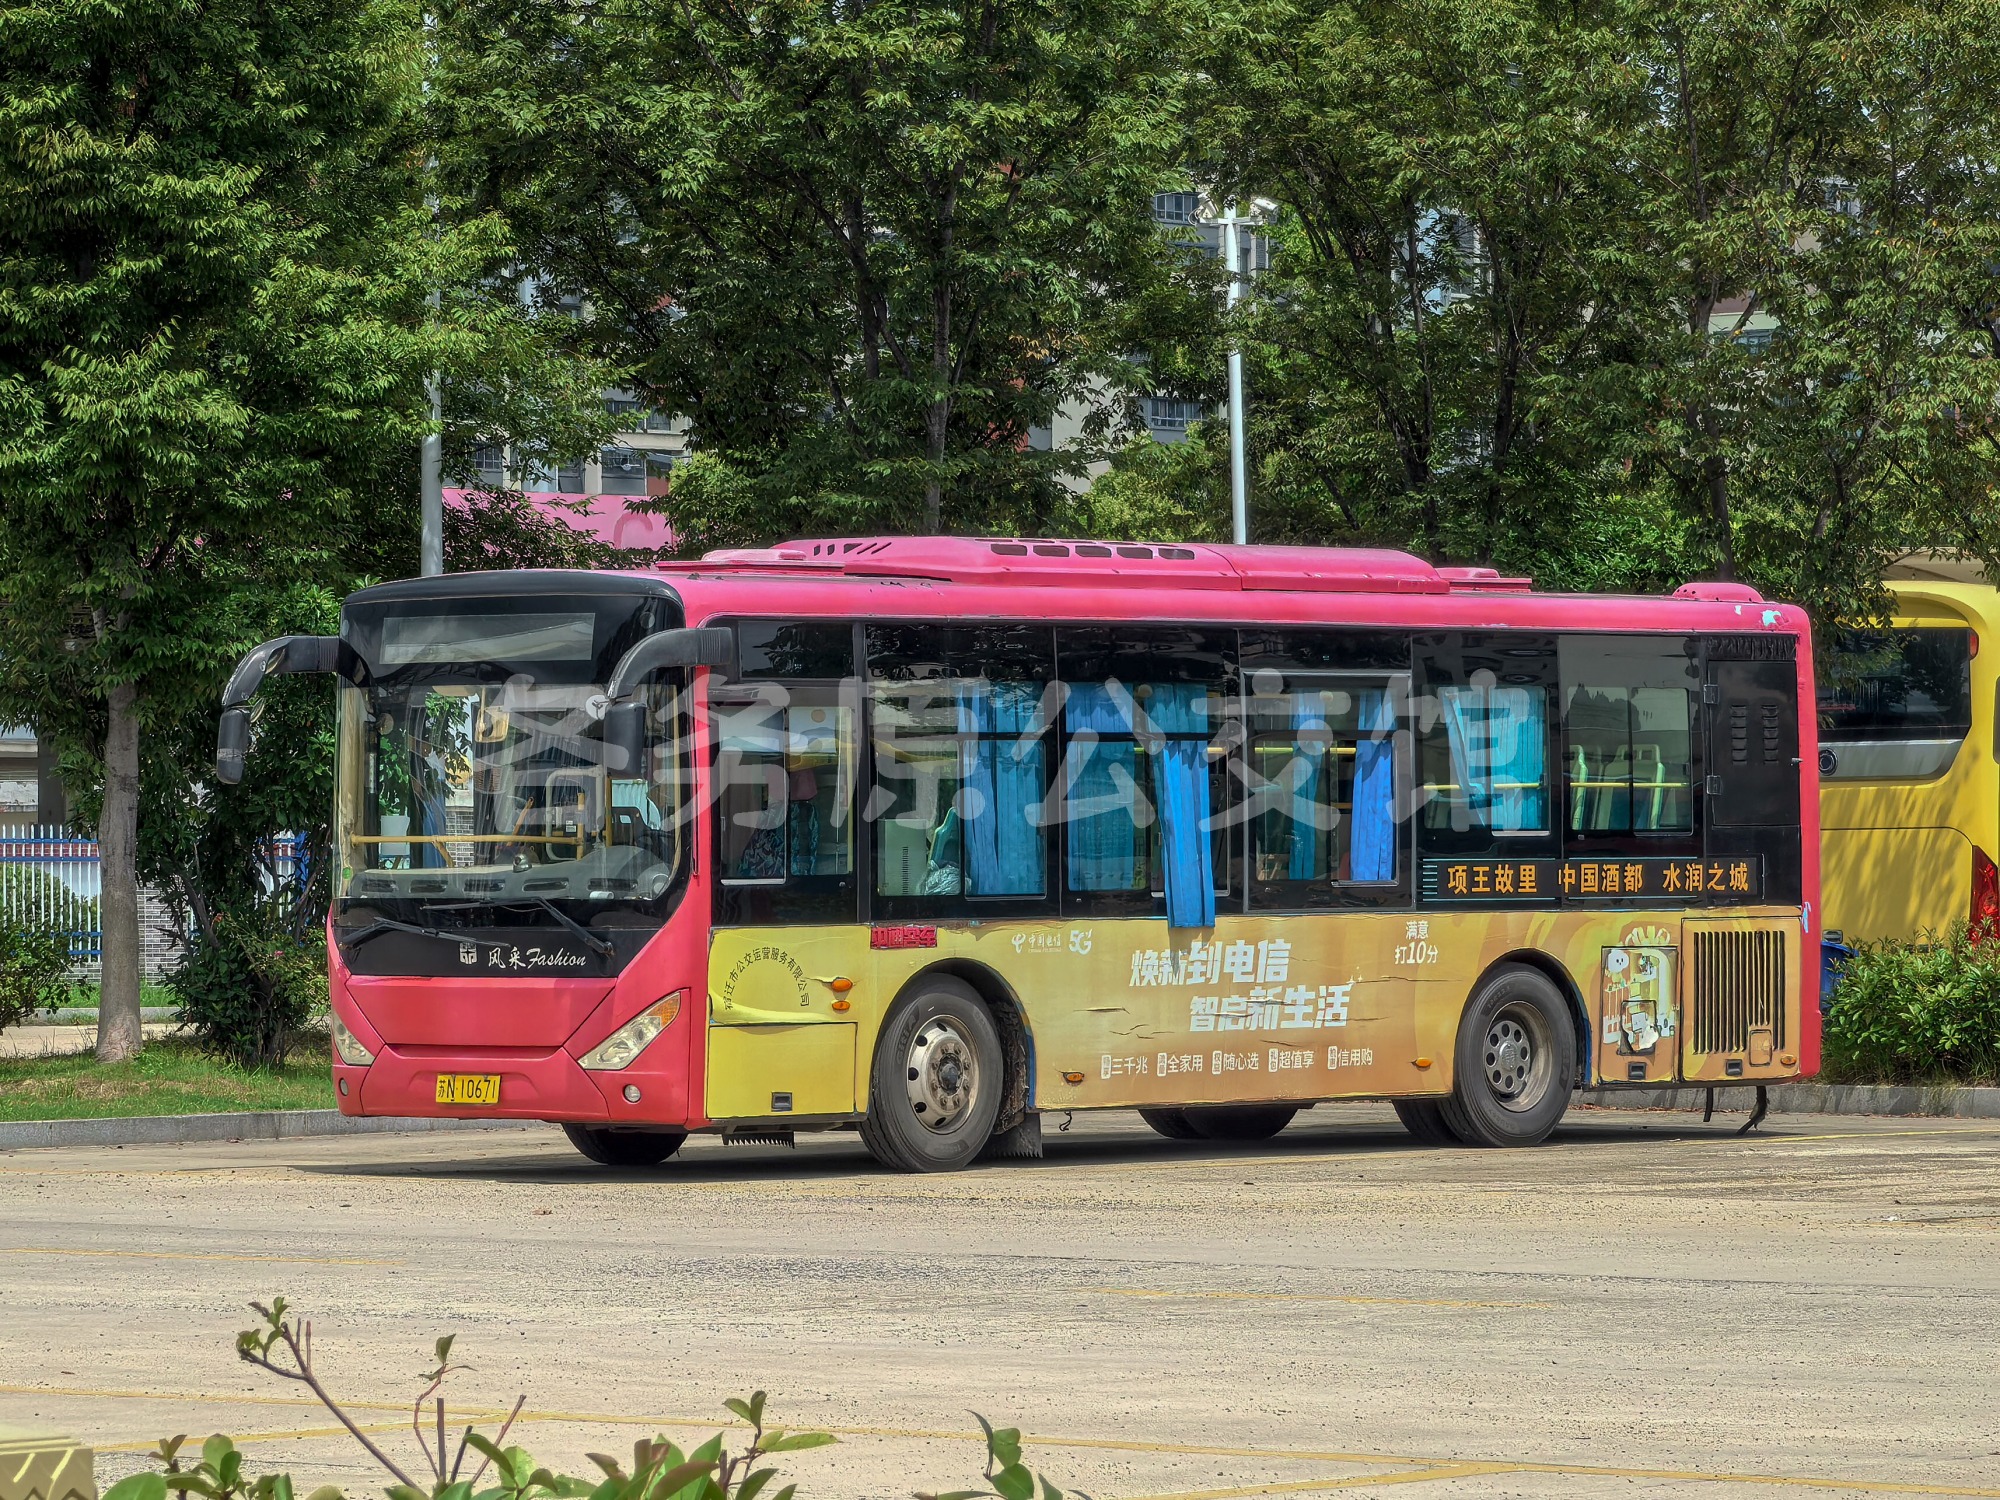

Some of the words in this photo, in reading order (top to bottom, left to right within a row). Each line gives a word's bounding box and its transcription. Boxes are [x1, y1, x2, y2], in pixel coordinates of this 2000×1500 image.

[1447, 864, 1538, 894] 项王故里
[1557, 863, 1644, 893] 中国酒都
[1662, 862, 1749, 892] 水润之城
[1068, 929, 1093, 955] 5G
[1405, 920, 1429, 940] 满意
[488, 946, 526, 971] 风采
[526, 947, 587, 970] Fashion
[1129, 938, 1292, 987] 焕新到电信
[1394, 941, 1439, 965] 打10分
[723, 946, 809, 1010] 宿迁市公交运营服务有限公司
[1189, 984, 1352, 1032] 智启新生活
[1111, 1055, 1149, 1076] 三千兆
[1167, 1053, 1204, 1073] 全家用
[1223, 1052, 1260, 1072] 随心选
[1279, 1049, 1315, 1069] 超值享
[1338, 1047, 1373, 1067] 信用购
